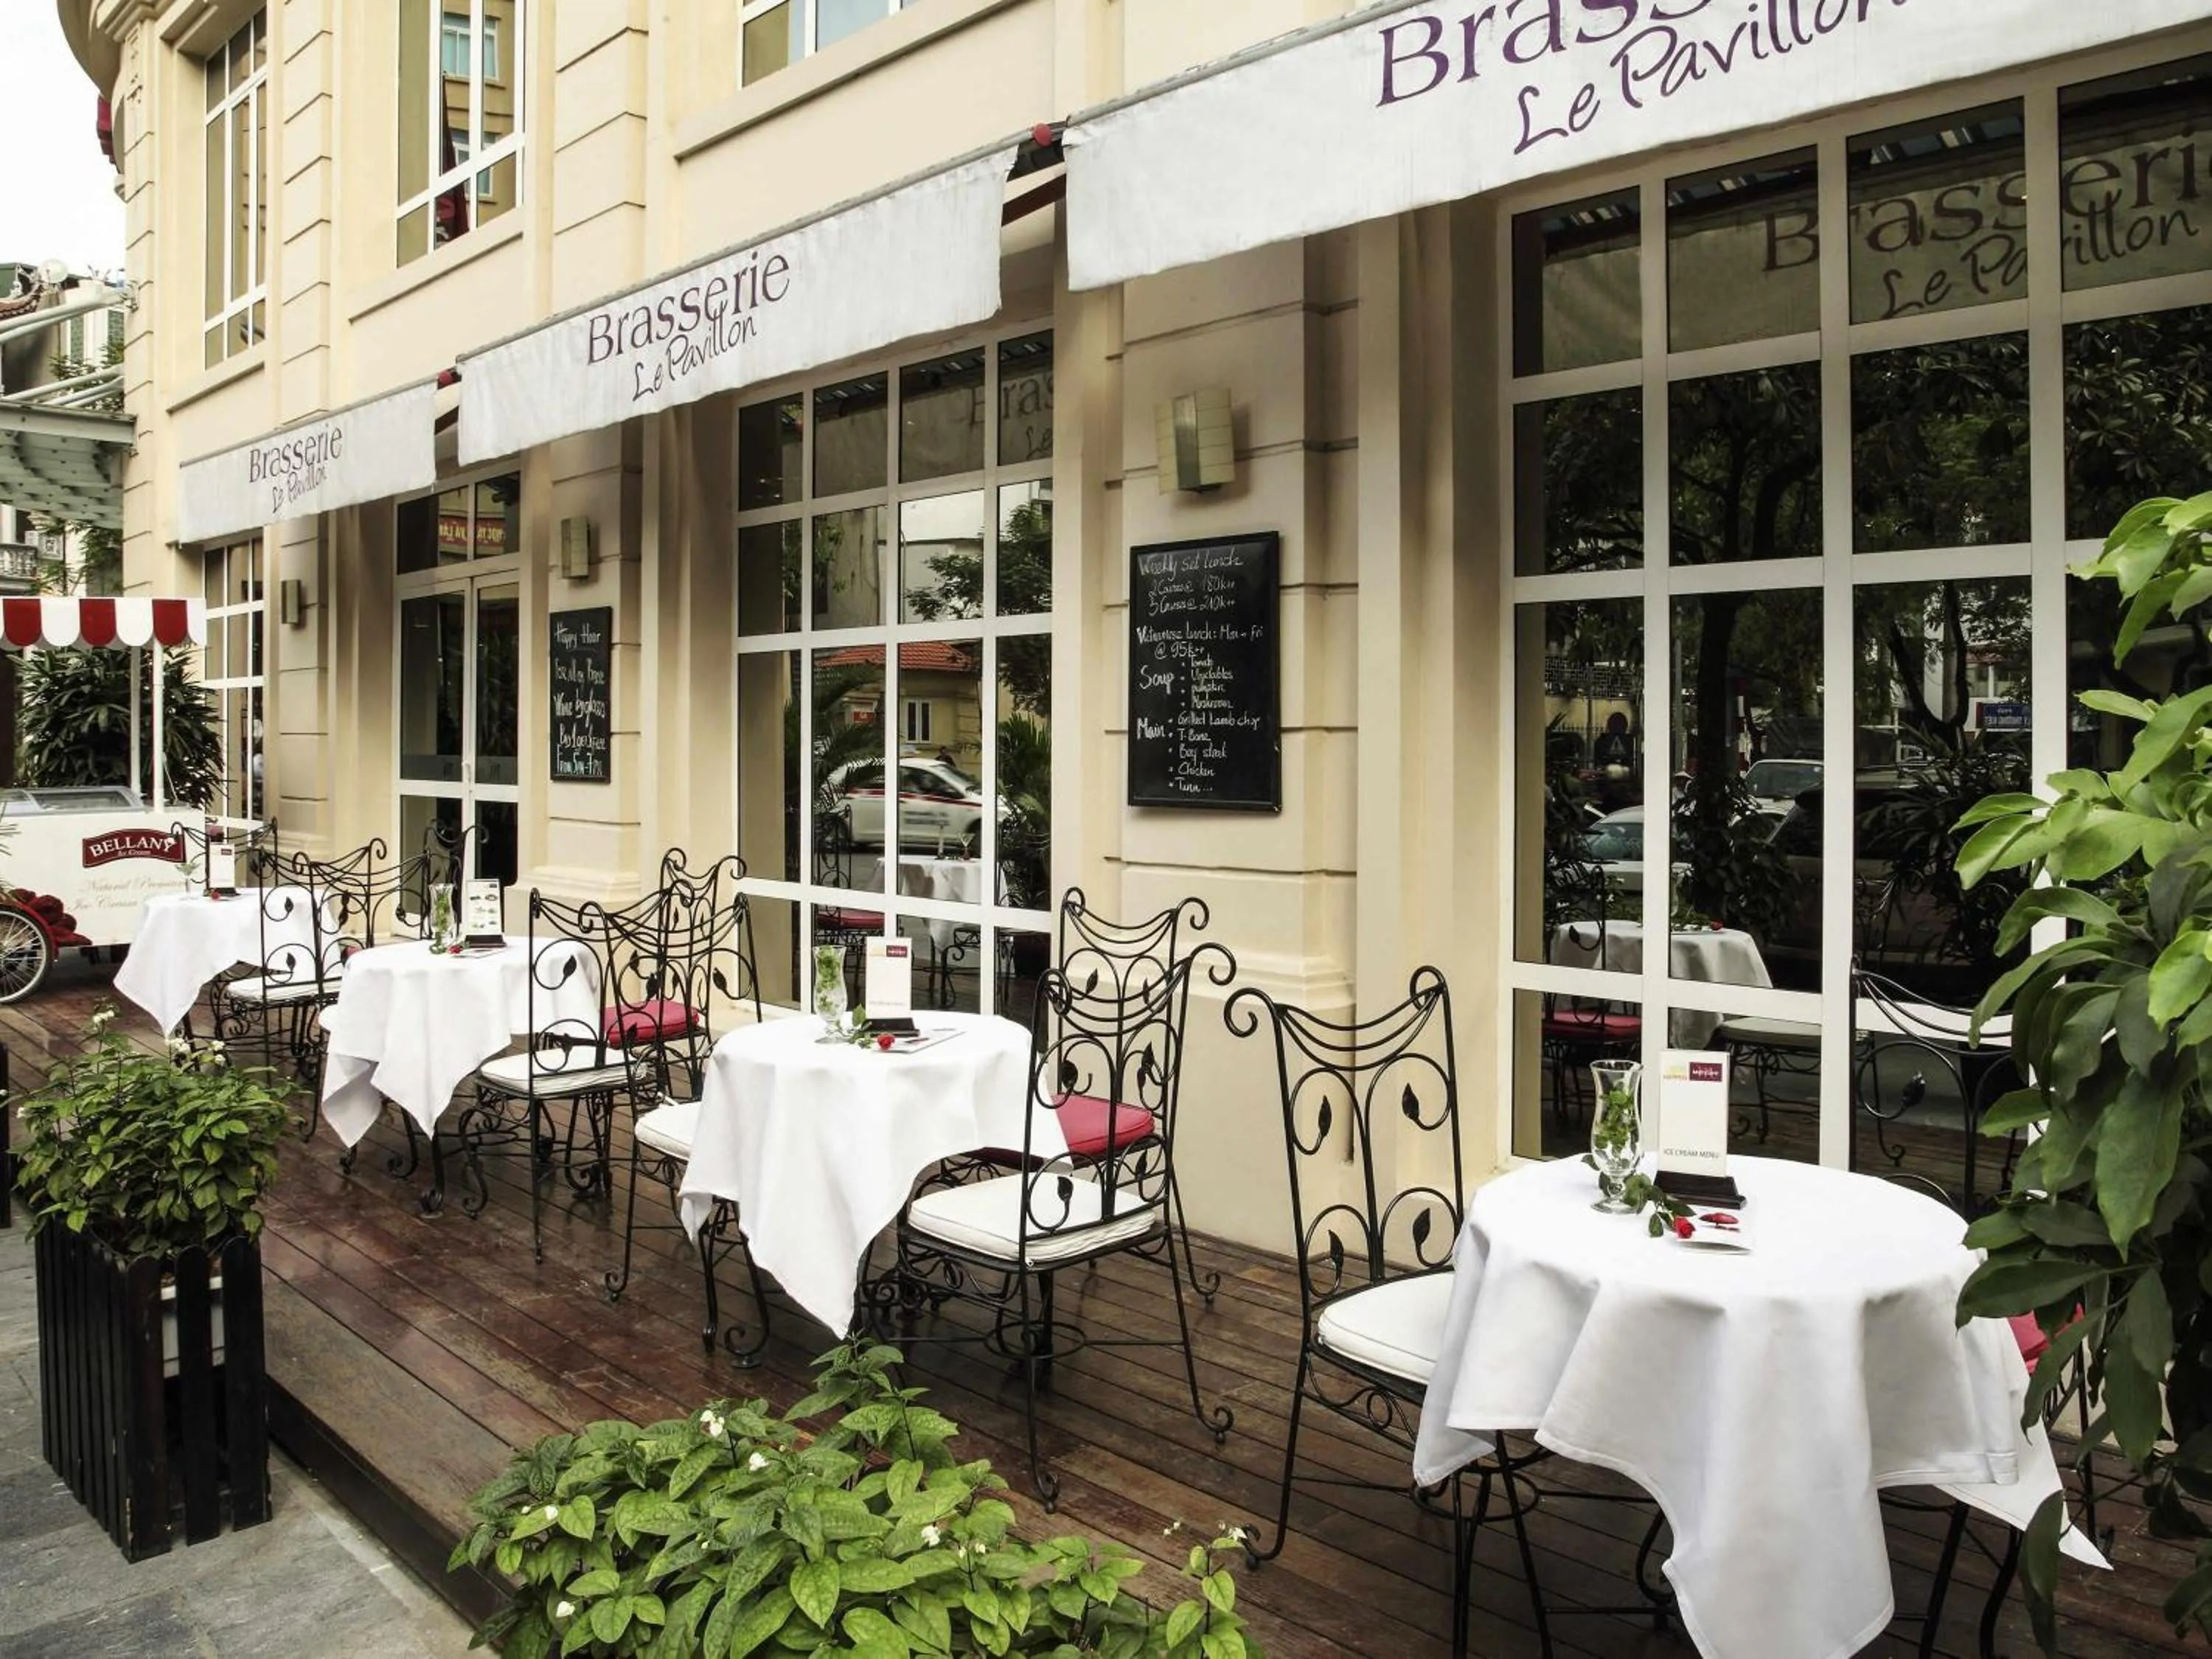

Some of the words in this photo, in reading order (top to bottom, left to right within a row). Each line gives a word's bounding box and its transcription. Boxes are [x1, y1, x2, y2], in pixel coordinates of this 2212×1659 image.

[1514, 83, 1601, 155] Le
[588, 251, 790, 366] Brasserie
[1880, 268, 1952, 321] Le
[632, 361, 663, 402] Le
[665, 298, 757, 381] Pavillon
[248, 422, 343, 484] Brasserie
